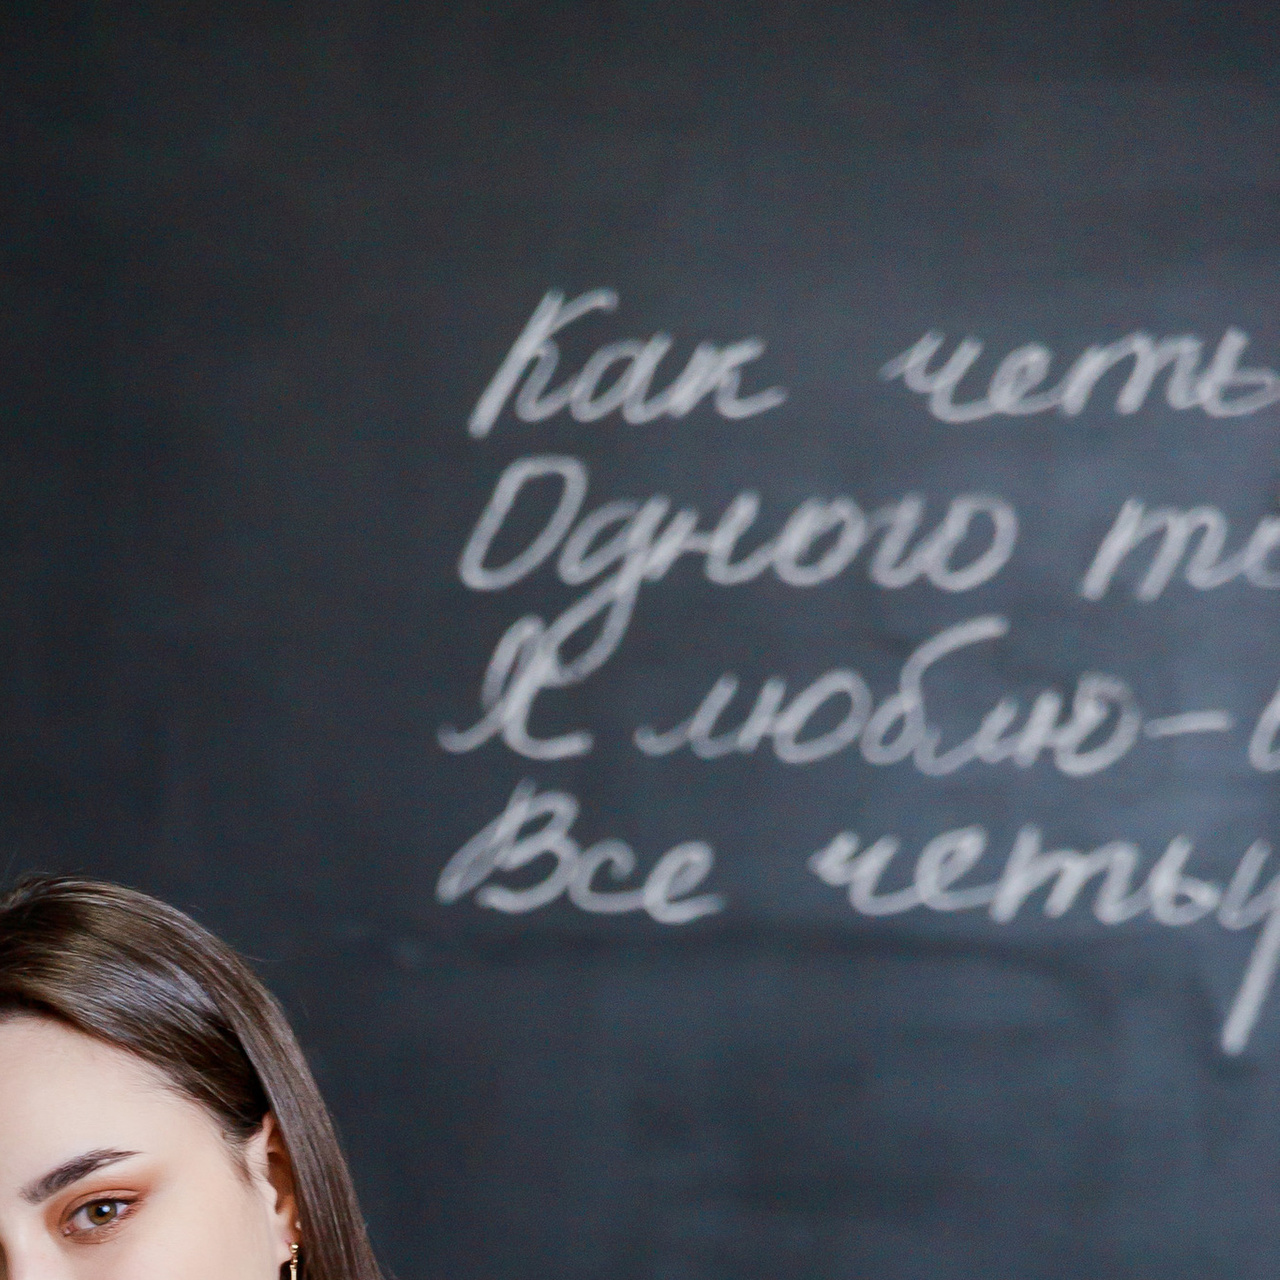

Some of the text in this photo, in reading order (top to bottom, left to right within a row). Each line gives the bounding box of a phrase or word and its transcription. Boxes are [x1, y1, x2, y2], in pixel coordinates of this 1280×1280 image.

[468, 288, 788, 438] Как
[456, 455, 1018, 687] Одного
[435, 778, 728, 925] Все
